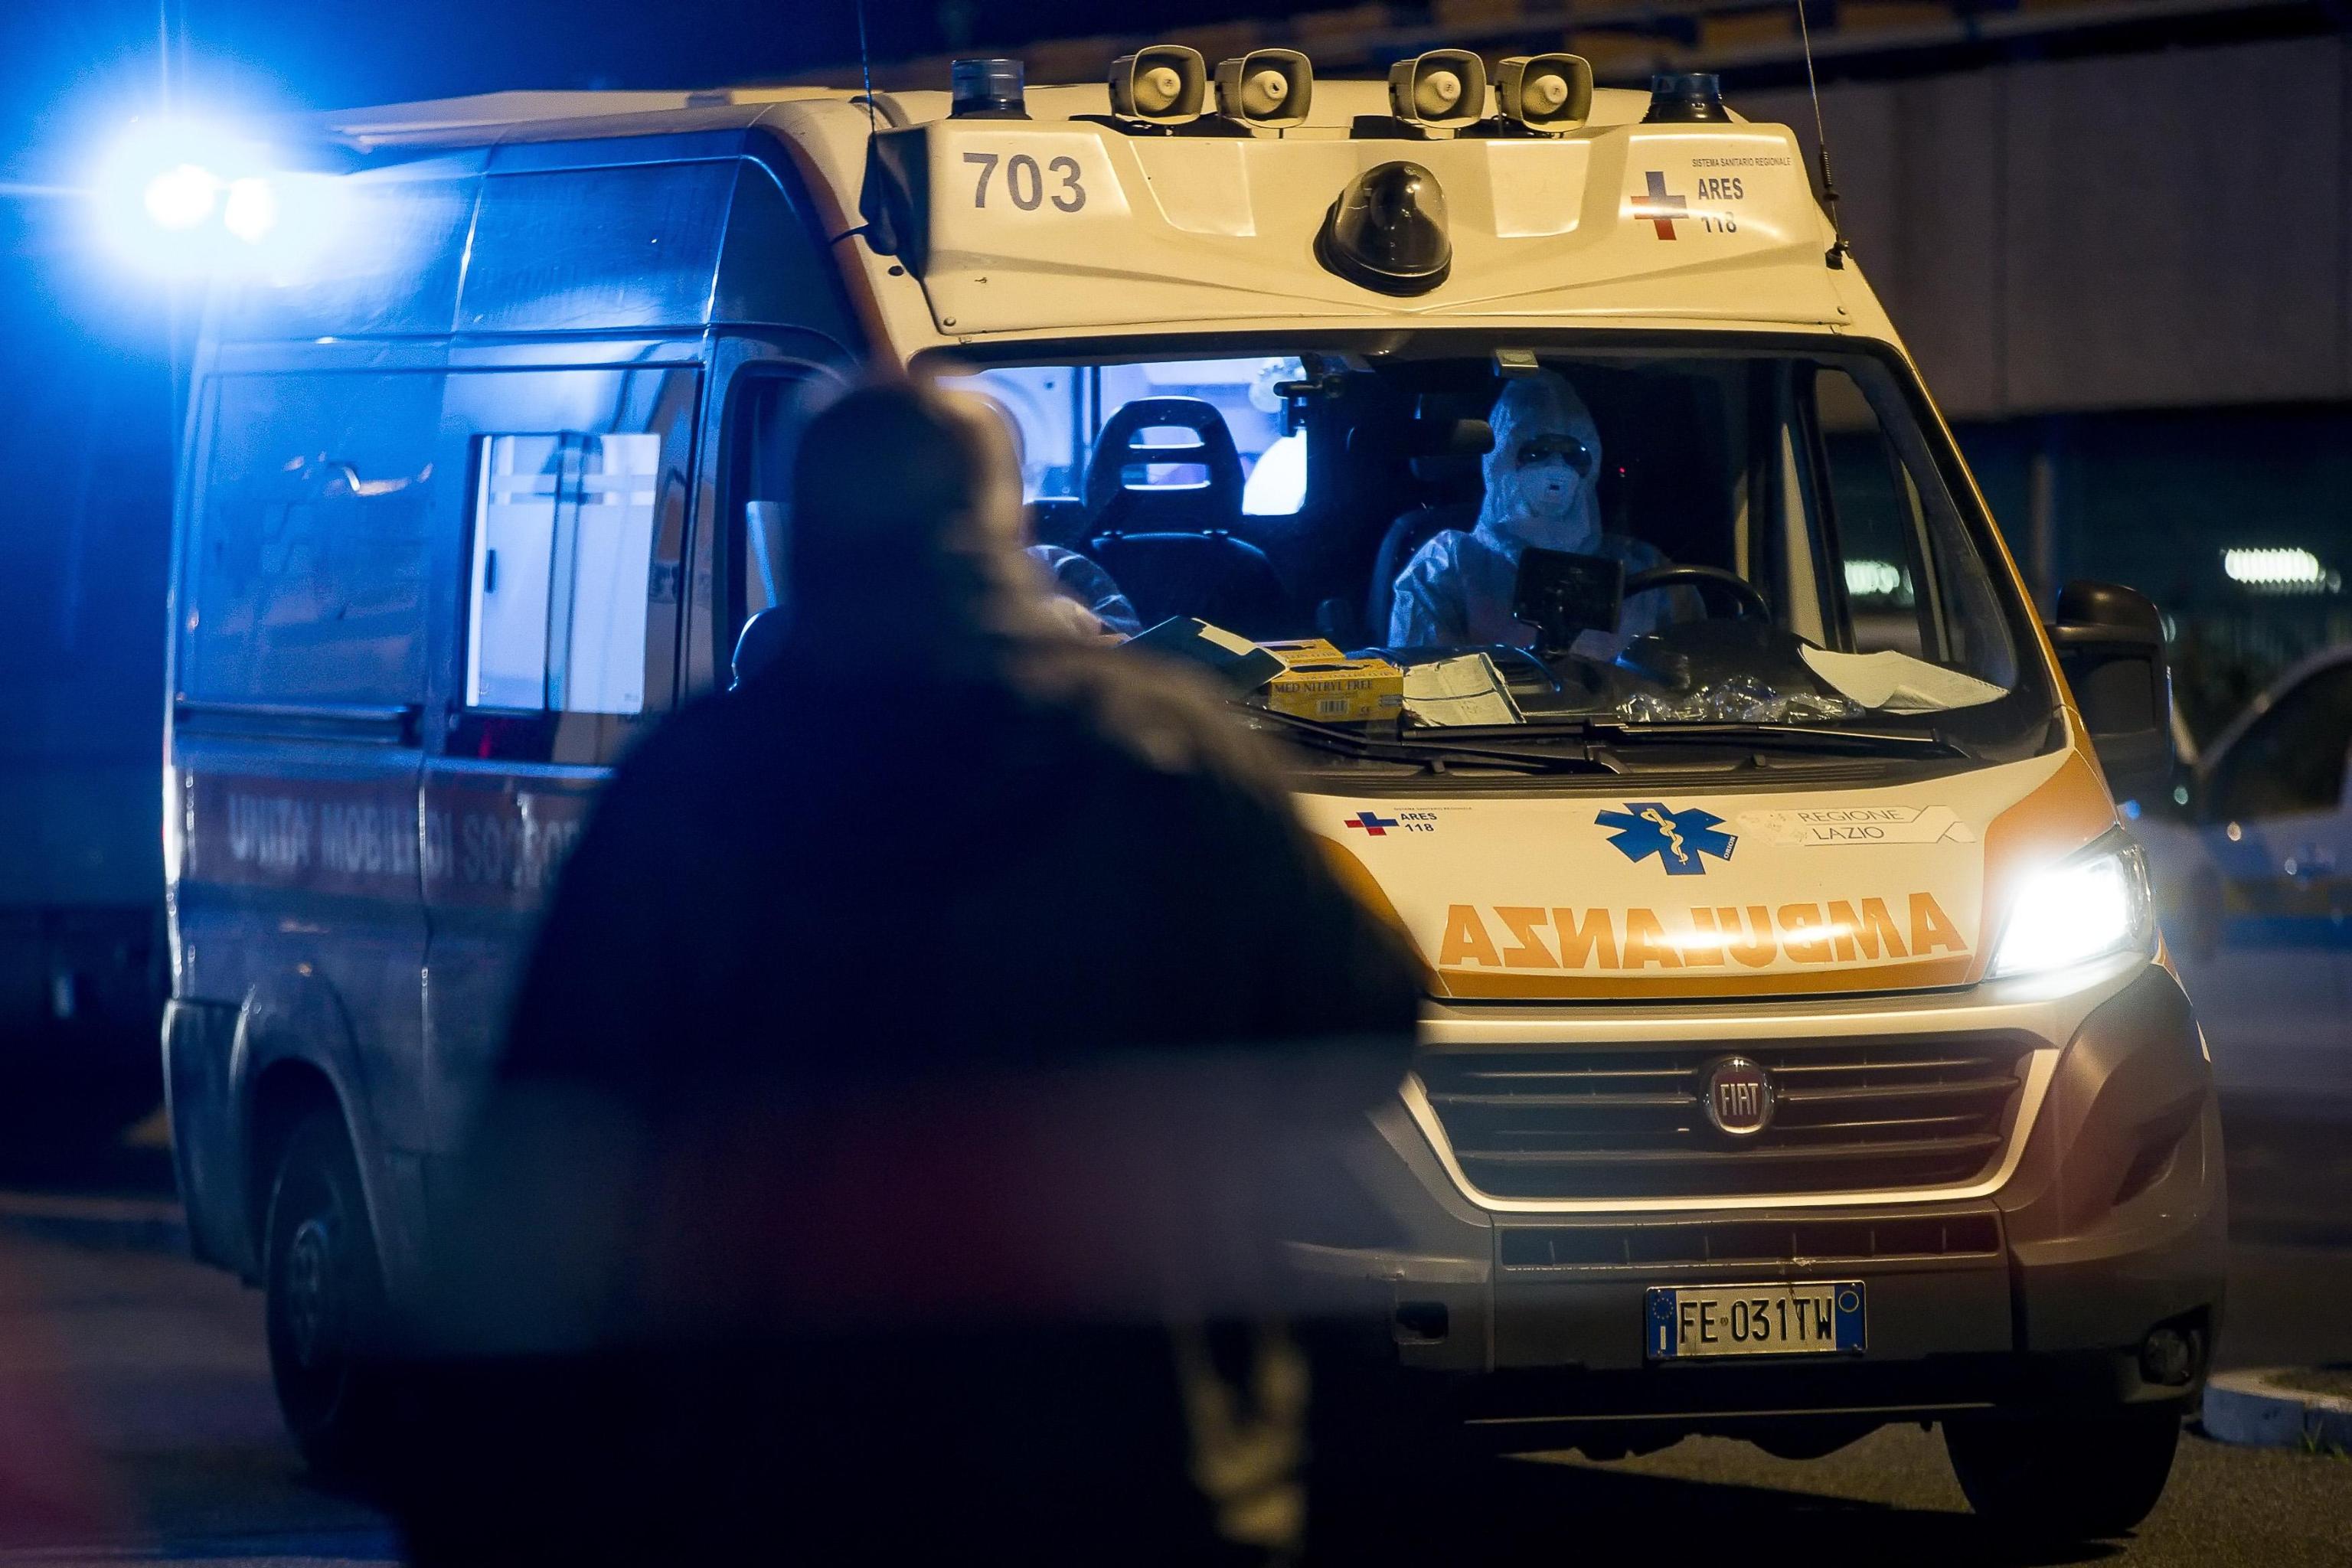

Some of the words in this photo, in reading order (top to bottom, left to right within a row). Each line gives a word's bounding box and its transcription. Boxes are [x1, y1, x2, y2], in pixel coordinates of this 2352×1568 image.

[1692, 158, 1719, 167] SISTEMA
[1720, 158, 1754, 167] SANITARIO
[1755, 157, 1792, 166] REGIONALE
[963, 152, 1086, 213] 703
[1698, 178, 1743, 200] ARES
[1700, 211, 1737, 233] 118
[1400, 812, 1437, 821] ARES
[1798, 809, 1905, 822] REGIONE
[1405, 823, 1434, 832] 118
[1812, 826, 1885, 841] LAZIO
[1723, 835, 1736, 859] ORION
[1720, 1083, 1759, 1116] FIAT
